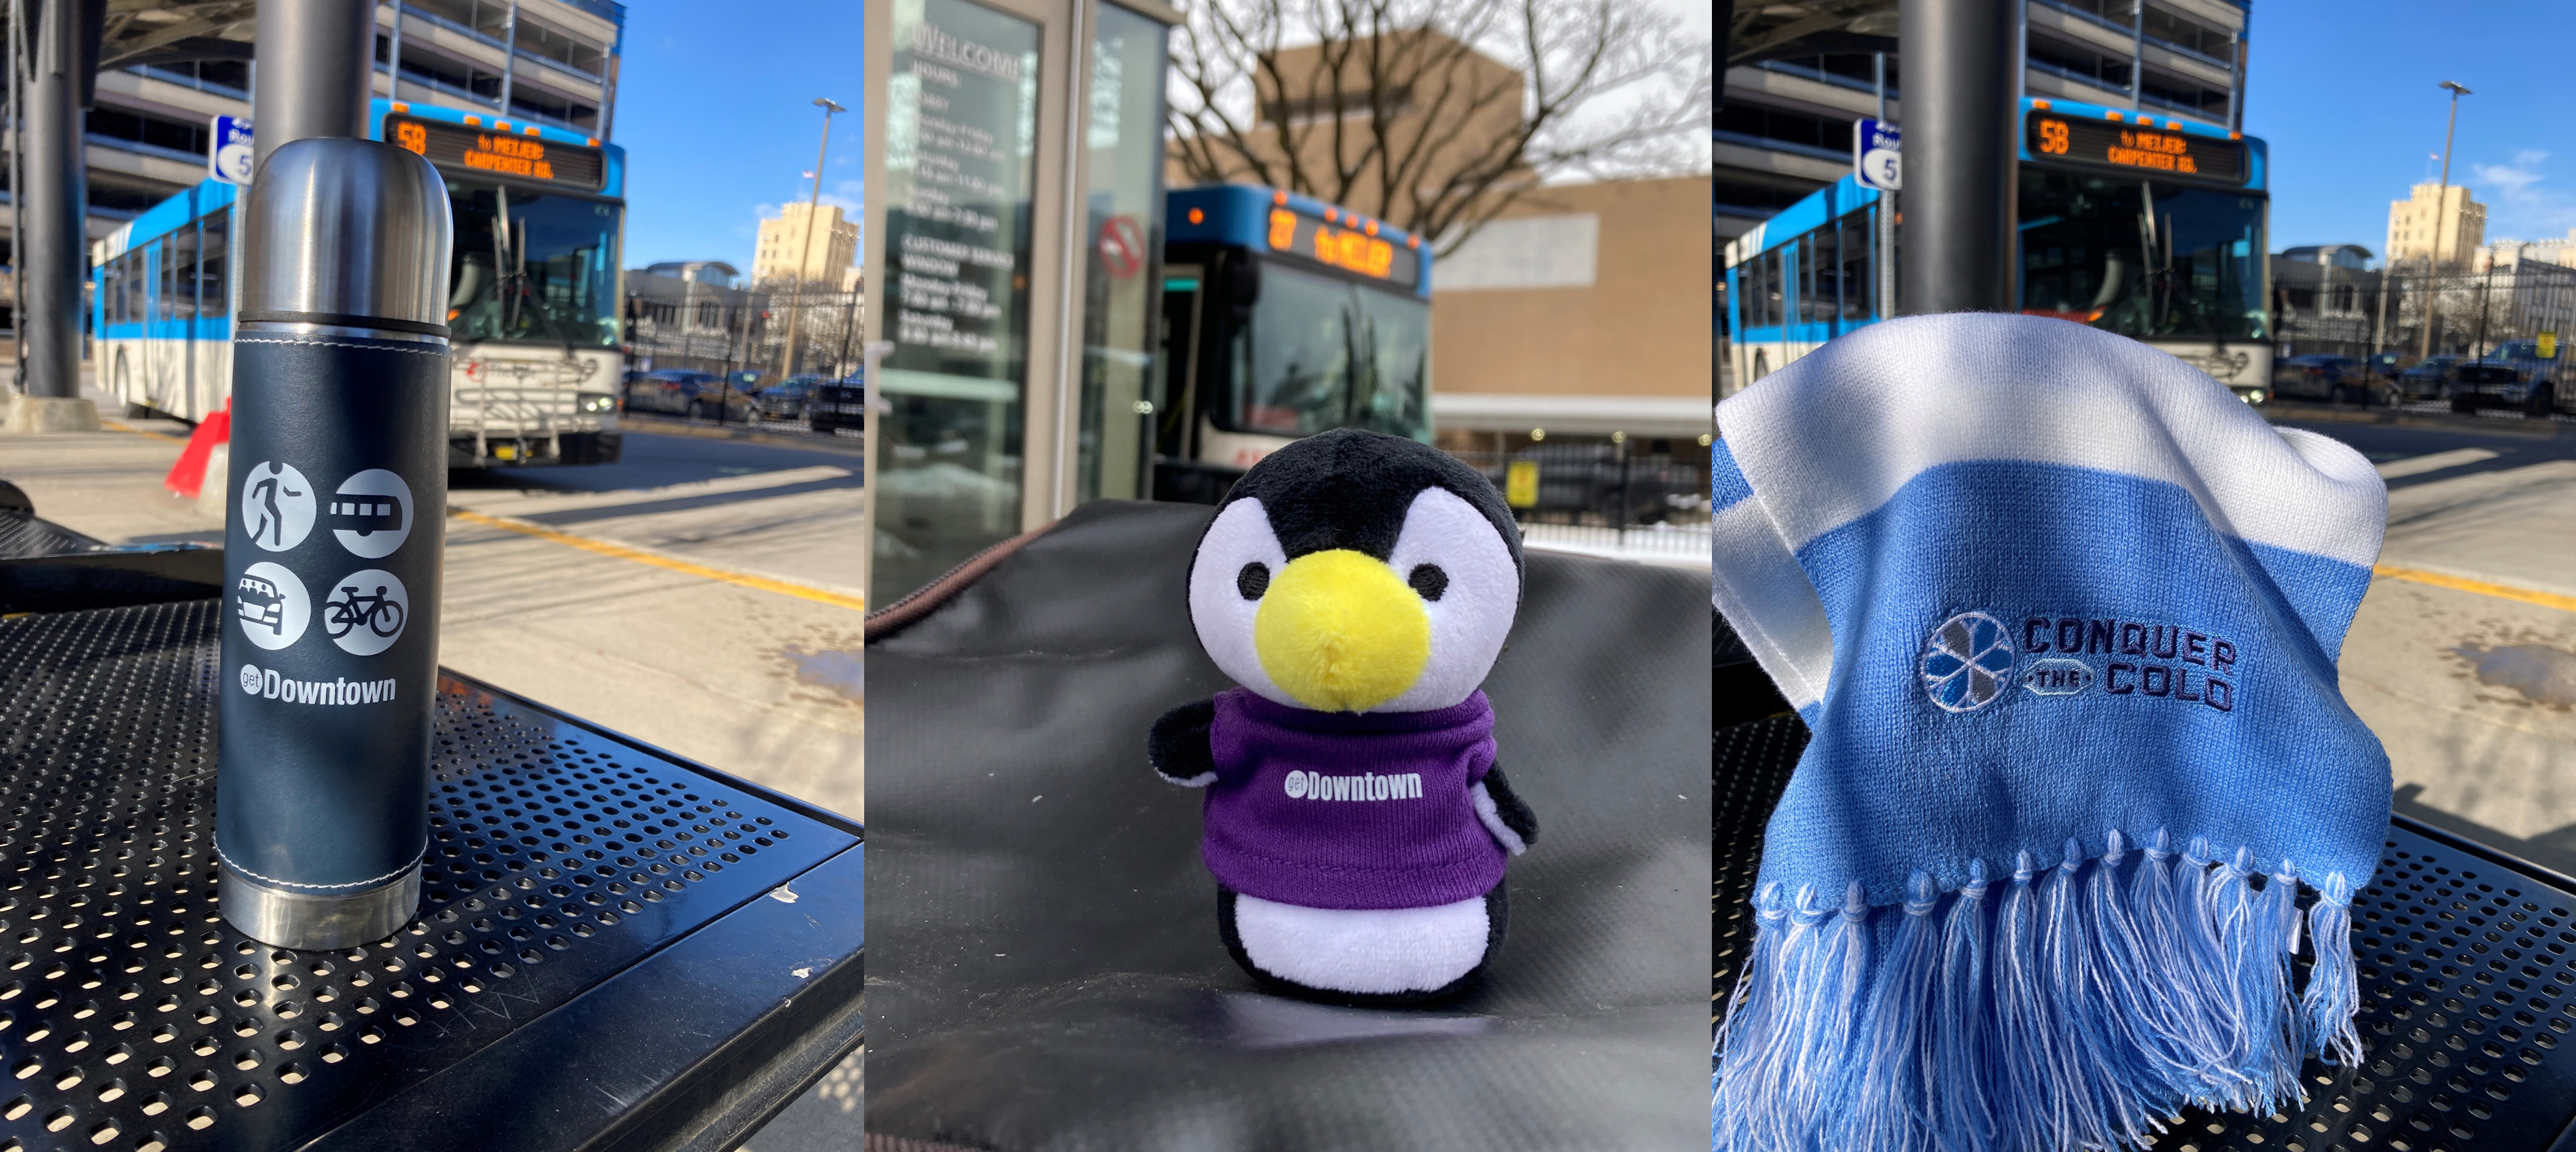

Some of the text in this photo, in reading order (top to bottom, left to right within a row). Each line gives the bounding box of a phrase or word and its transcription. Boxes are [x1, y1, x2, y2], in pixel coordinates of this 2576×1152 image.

[2024, 616, 2237, 676] CONQUER
[243, 669, 396, 705] get Downtown
[2037, 662, 2232, 712] THE COLD
[1308, 771, 1423, 801] Downtown
